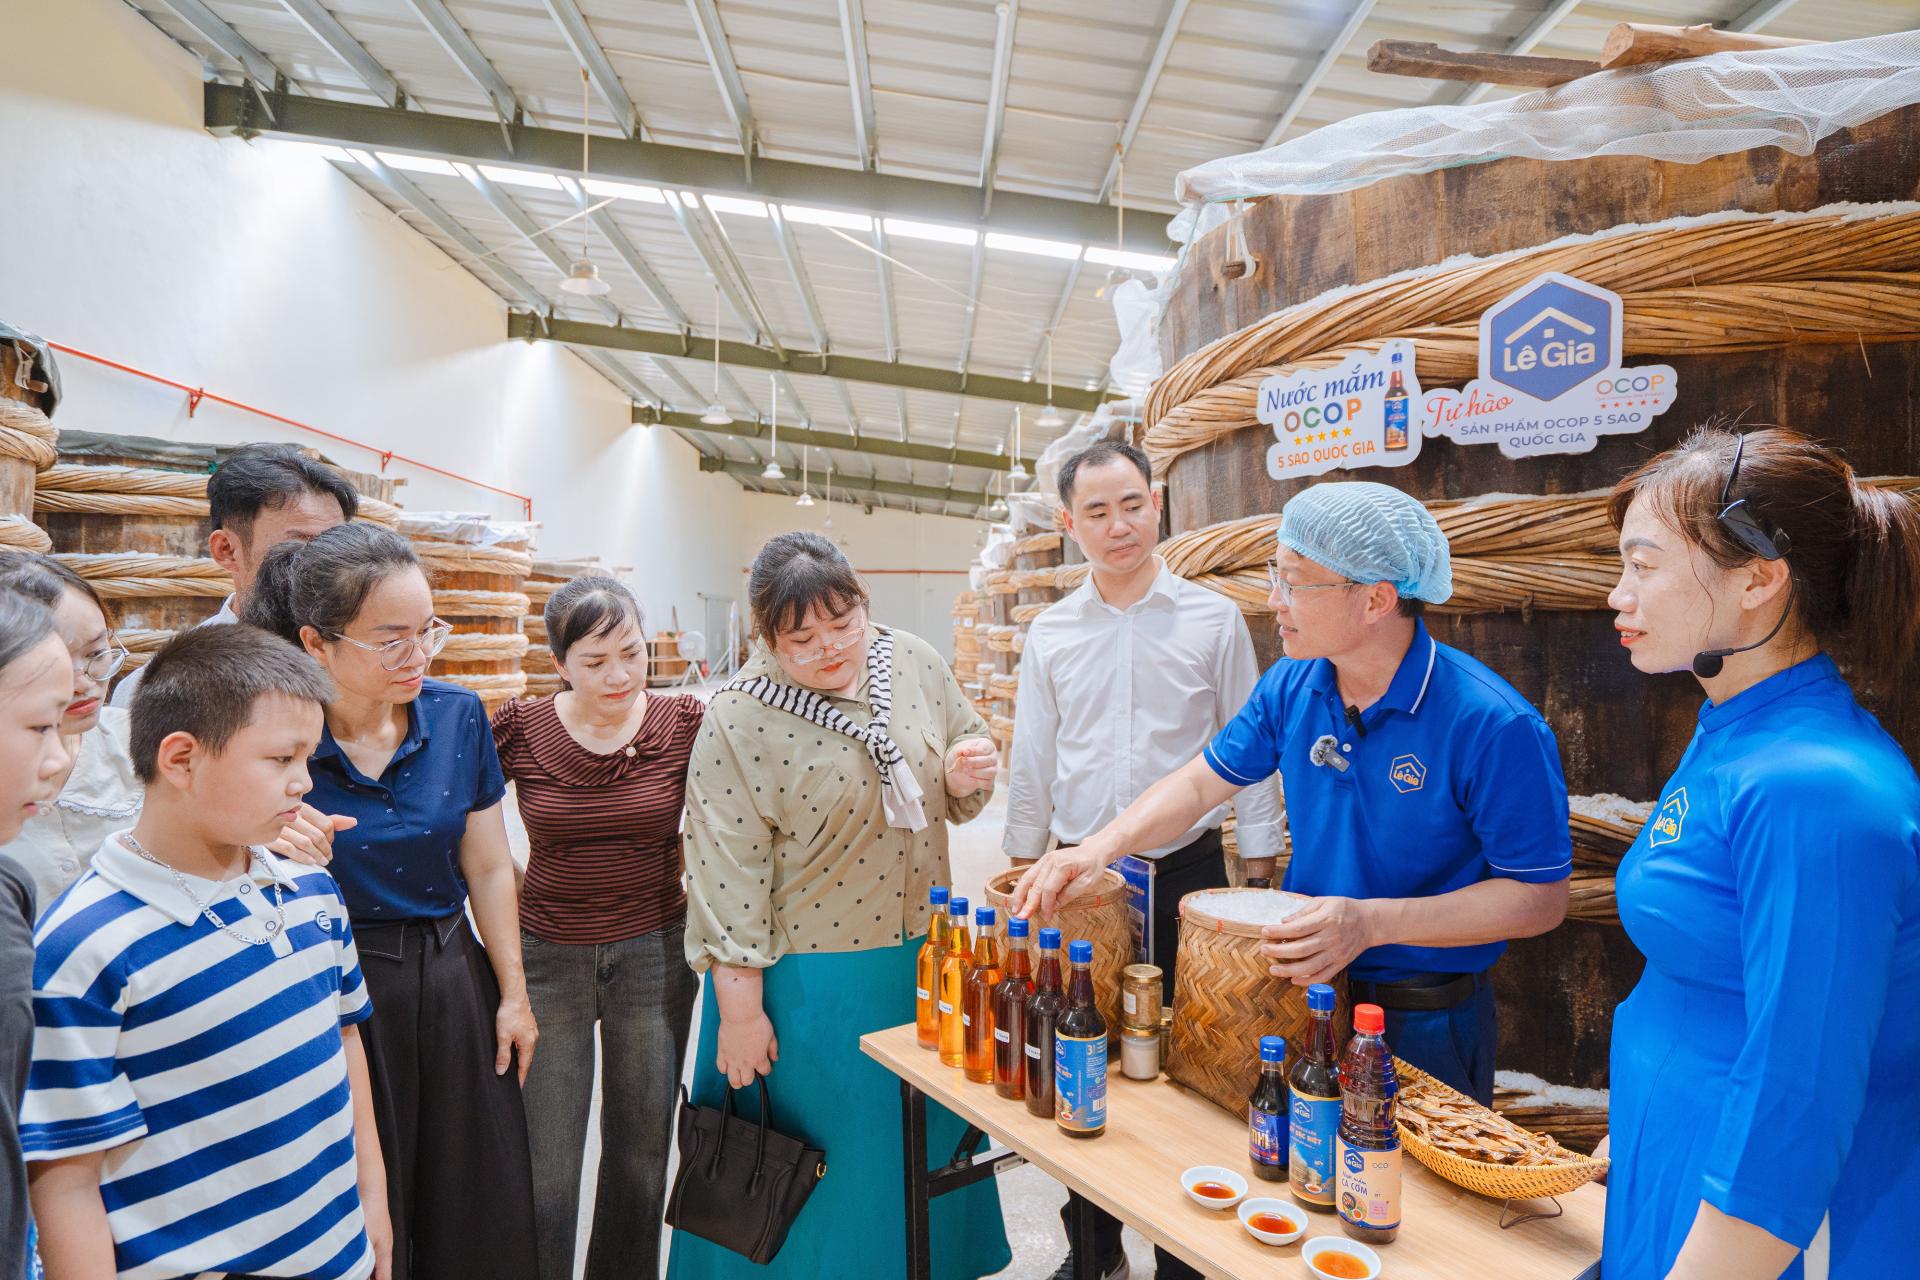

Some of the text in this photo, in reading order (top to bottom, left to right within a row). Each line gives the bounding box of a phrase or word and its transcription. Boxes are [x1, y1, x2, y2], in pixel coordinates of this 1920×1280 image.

[1503, 340, 1595, 372] Lê Gia
[1266, 363, 1385, 412] Nước mắm
[1596, 374, 1666, 395] OCOP
[1284, 398, 1362, 433] OCOP
[1464, 388, 1514, 417] hào
[1544, 416, 1589, 430] OCOP
[1594, 415, 1603, 426] 5
[1607, 412, 1642, 425] SAO
[1558, 432, 1587, 443] GIA
[1278, 456, 1285, 469] 5
[1287, 451, 1311, 467] SAO
[1352, 440, 1376, 456] GIA
